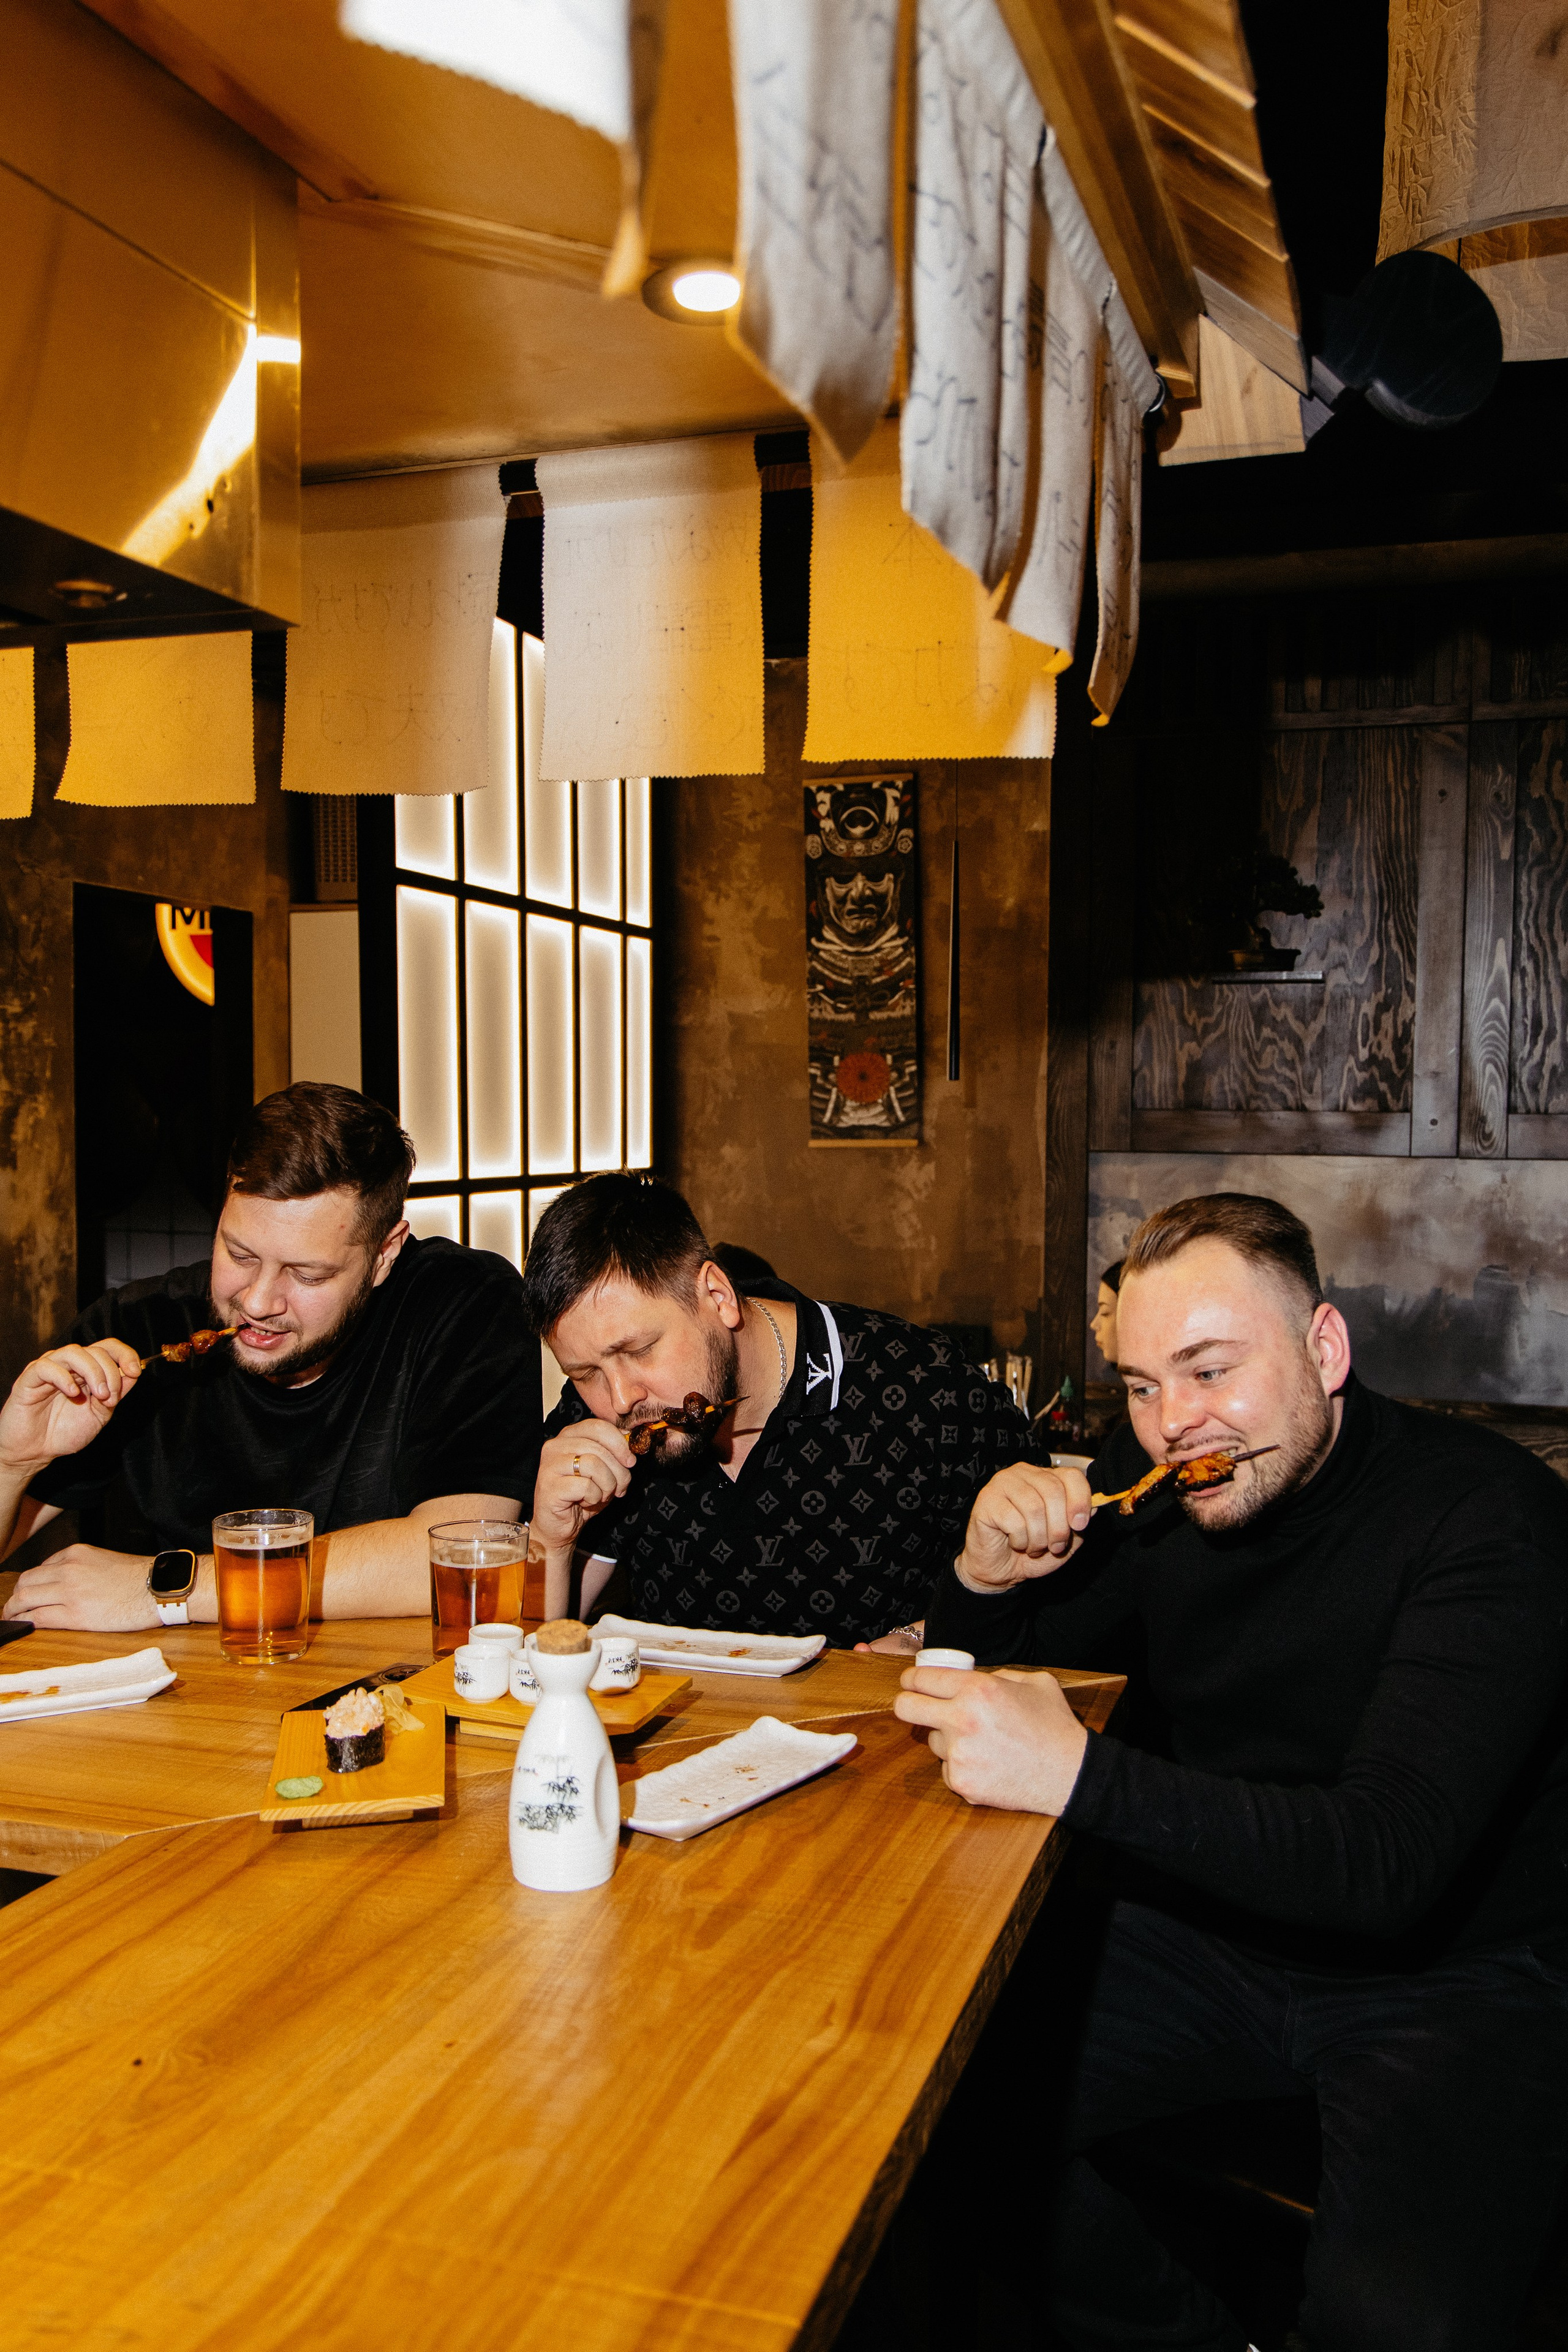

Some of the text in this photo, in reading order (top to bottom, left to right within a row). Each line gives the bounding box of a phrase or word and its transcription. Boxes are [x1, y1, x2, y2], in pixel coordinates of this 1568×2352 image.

[842, 1433, 872, 1466] LV
[754, 1535, 785, 1567] LV
[850, 1536, 883, 1566] LV
